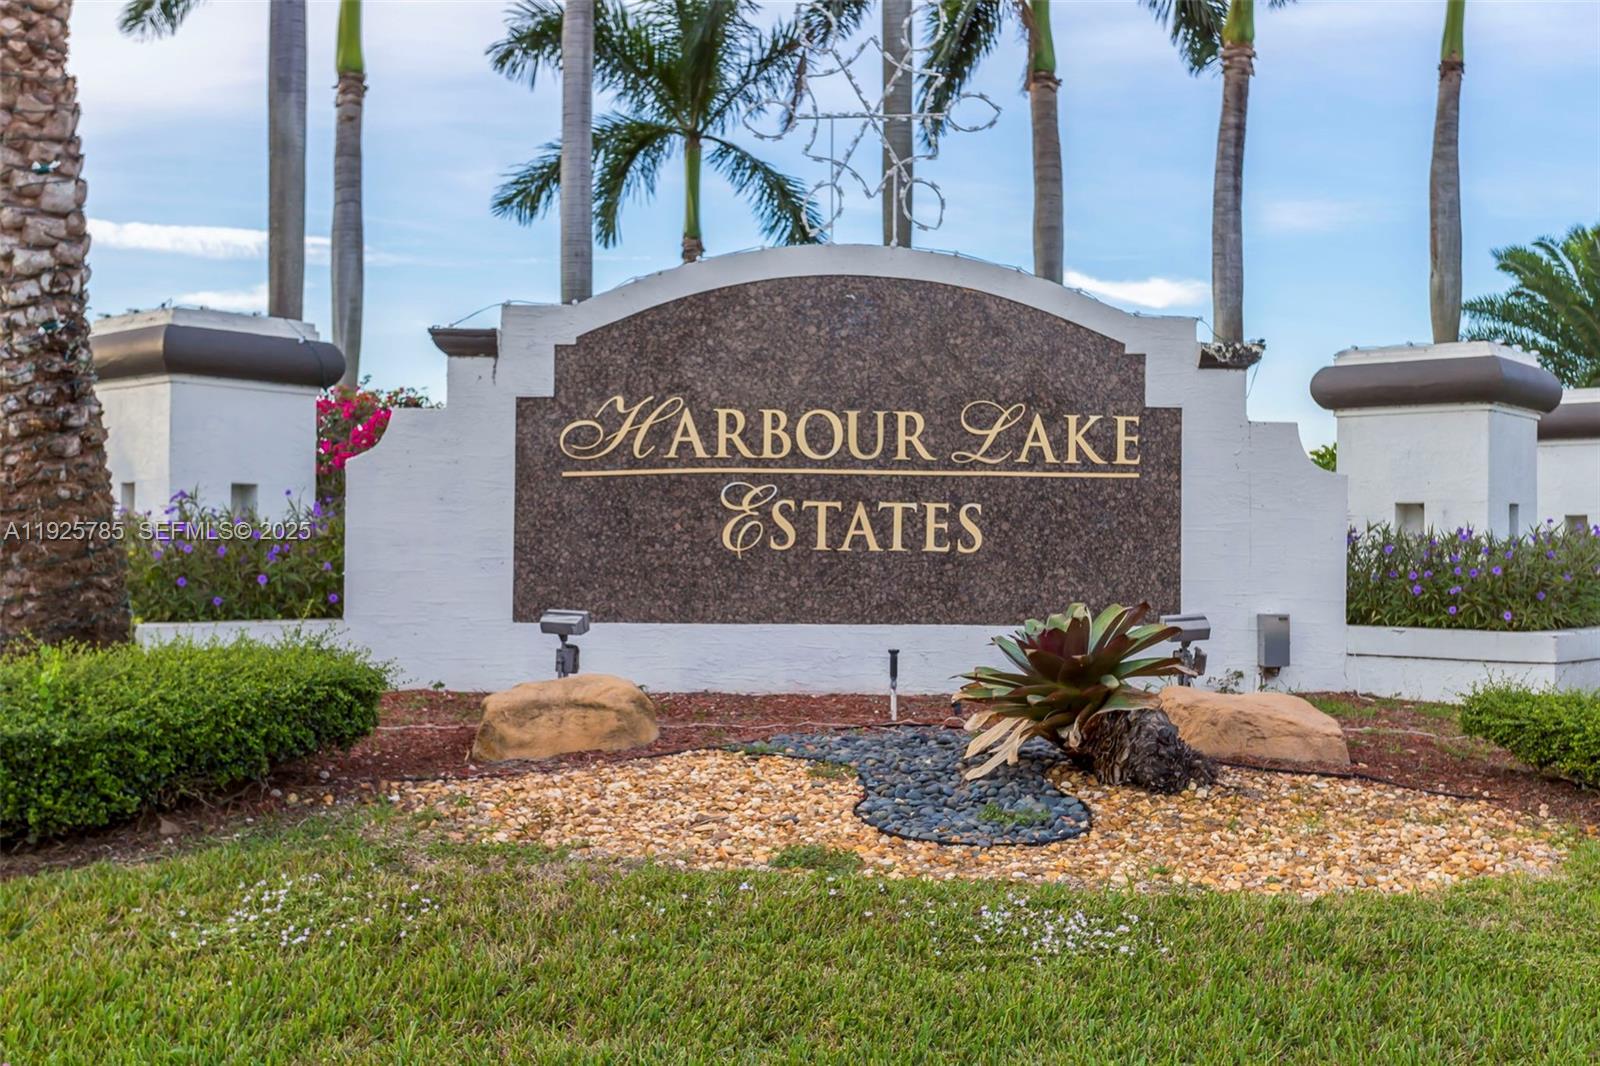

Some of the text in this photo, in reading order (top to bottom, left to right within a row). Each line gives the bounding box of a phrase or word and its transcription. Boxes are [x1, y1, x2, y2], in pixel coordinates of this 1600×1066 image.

[559, 395, 1141, 465] HARBOUR LAKE
[720, 481, 984, 559] ESTATES
